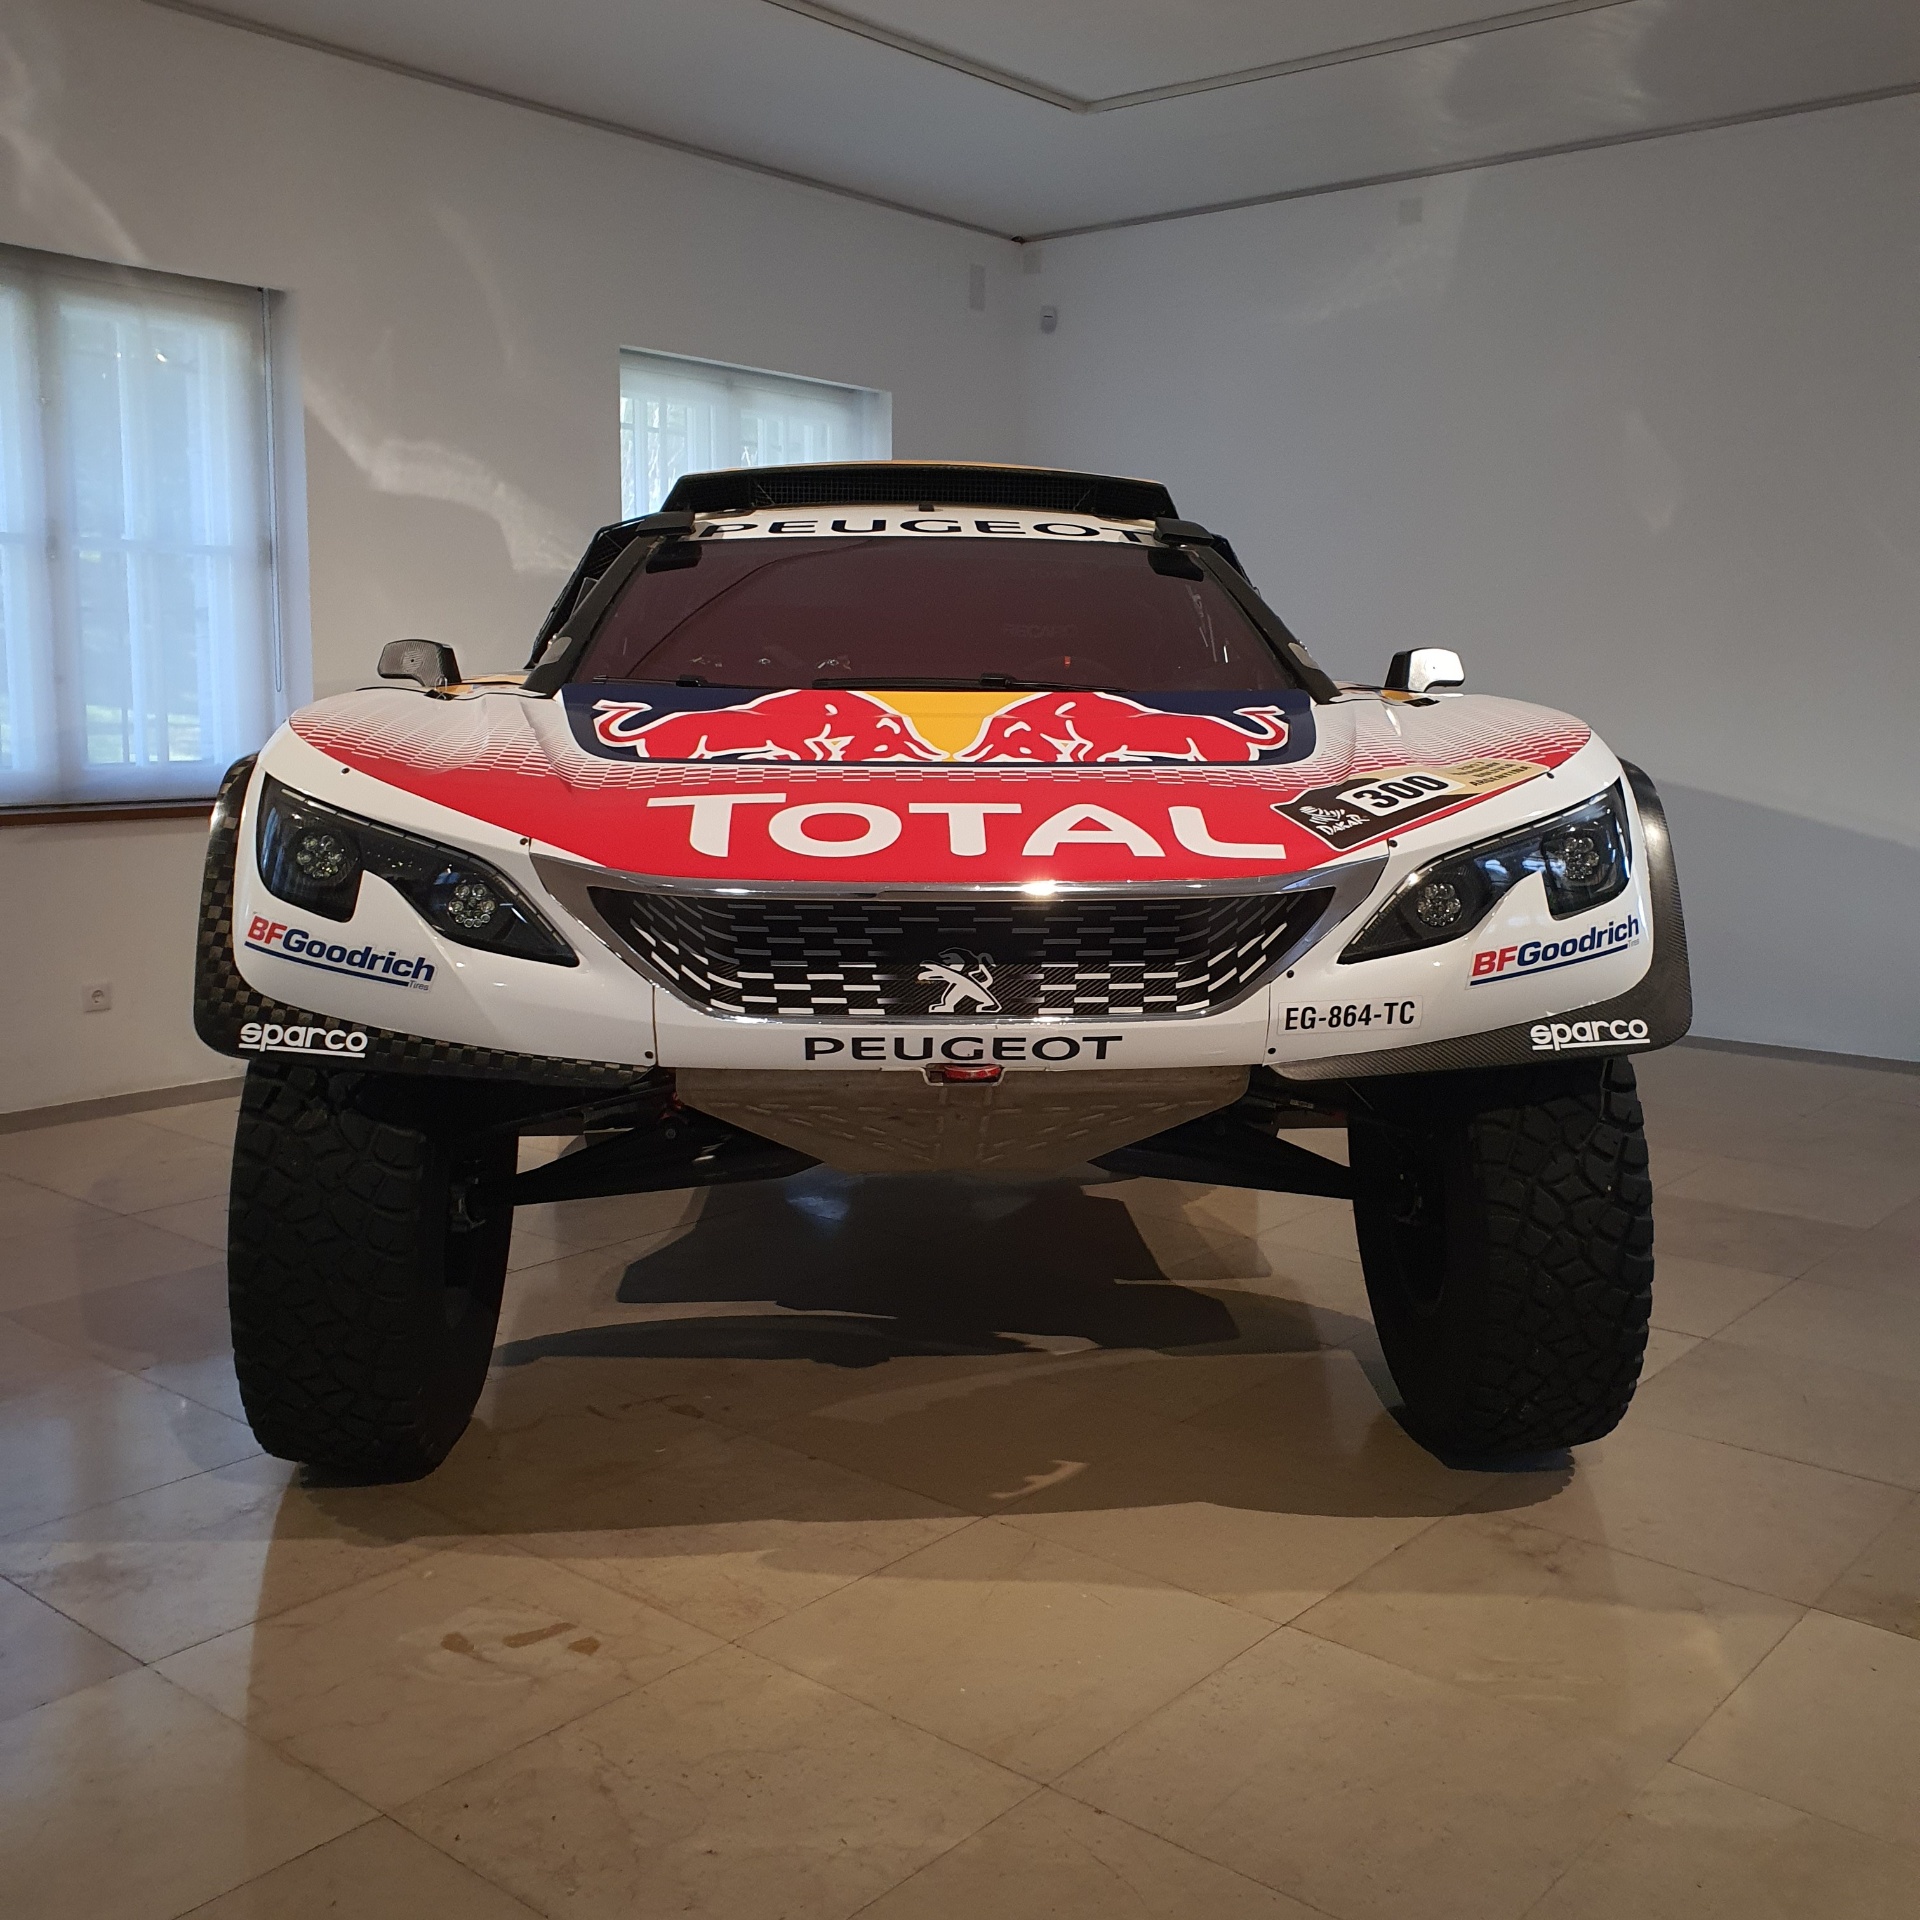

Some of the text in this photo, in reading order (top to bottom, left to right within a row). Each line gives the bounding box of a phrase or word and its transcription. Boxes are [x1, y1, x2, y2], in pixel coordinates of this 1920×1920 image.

[699, 518, 1153, 543] PEUGEOT
[1352, 775, 1449, 808] 300
[647, 792, 1287, 859] TOTAL
[247, 915, 436, 982] BFGoodrich
[1471, 914, 1640, 977] BFGoodrich
[408, 980, 430, 991] Tires
[1284, 1000, 1415, 1031] EG-864-TC
[240, 1022, 369, 1052] sparco
[804, 1035, 1123, 1061] PEUGEOT
[1529, 1018, 1649, 1051] sparco
